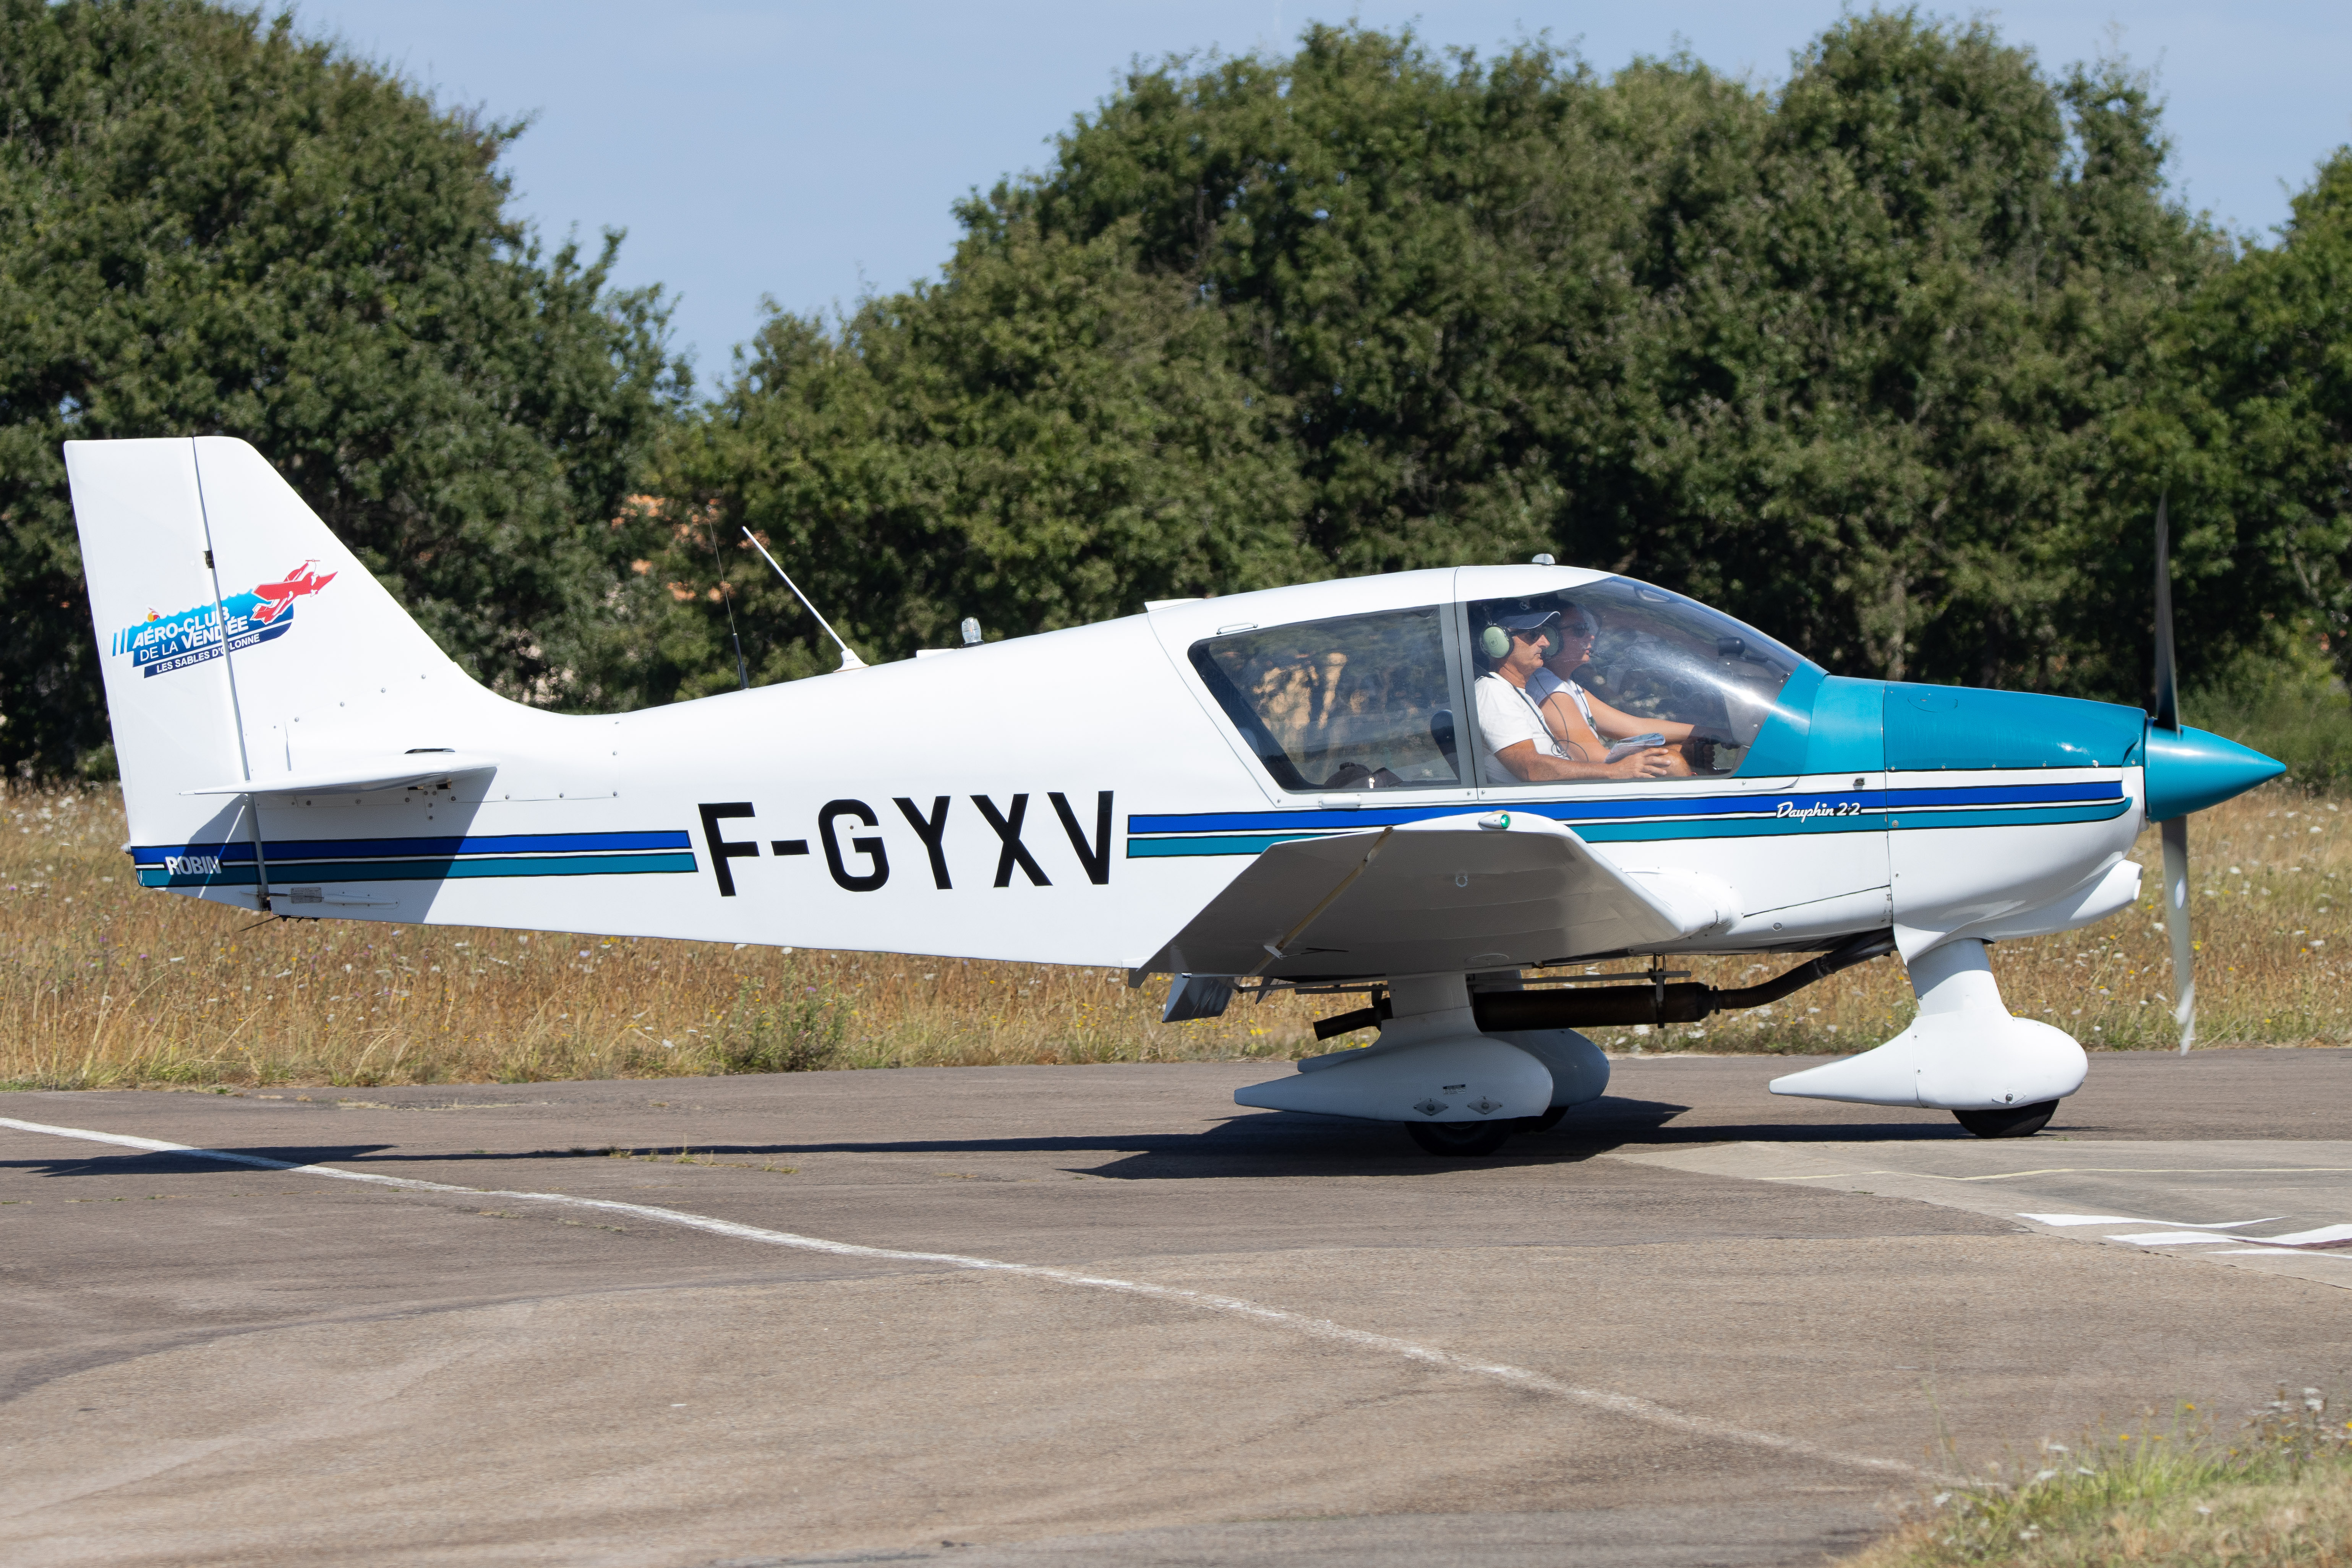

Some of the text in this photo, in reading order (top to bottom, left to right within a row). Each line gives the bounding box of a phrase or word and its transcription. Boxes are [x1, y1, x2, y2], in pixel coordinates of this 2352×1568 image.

[132, 606, 230, 649] AÉRO-CLUB
[140, 615, 249, 662] DE LA VENDÉE
[156, 660, 173, 673] LES
[175, 651, 210, 670] SABLES
[1776, 801, 1861, 824] Dauphin 2+2
[698, 790, 1114, 897] F-GYXV
[165, 855, 222, 876] ROBIN
